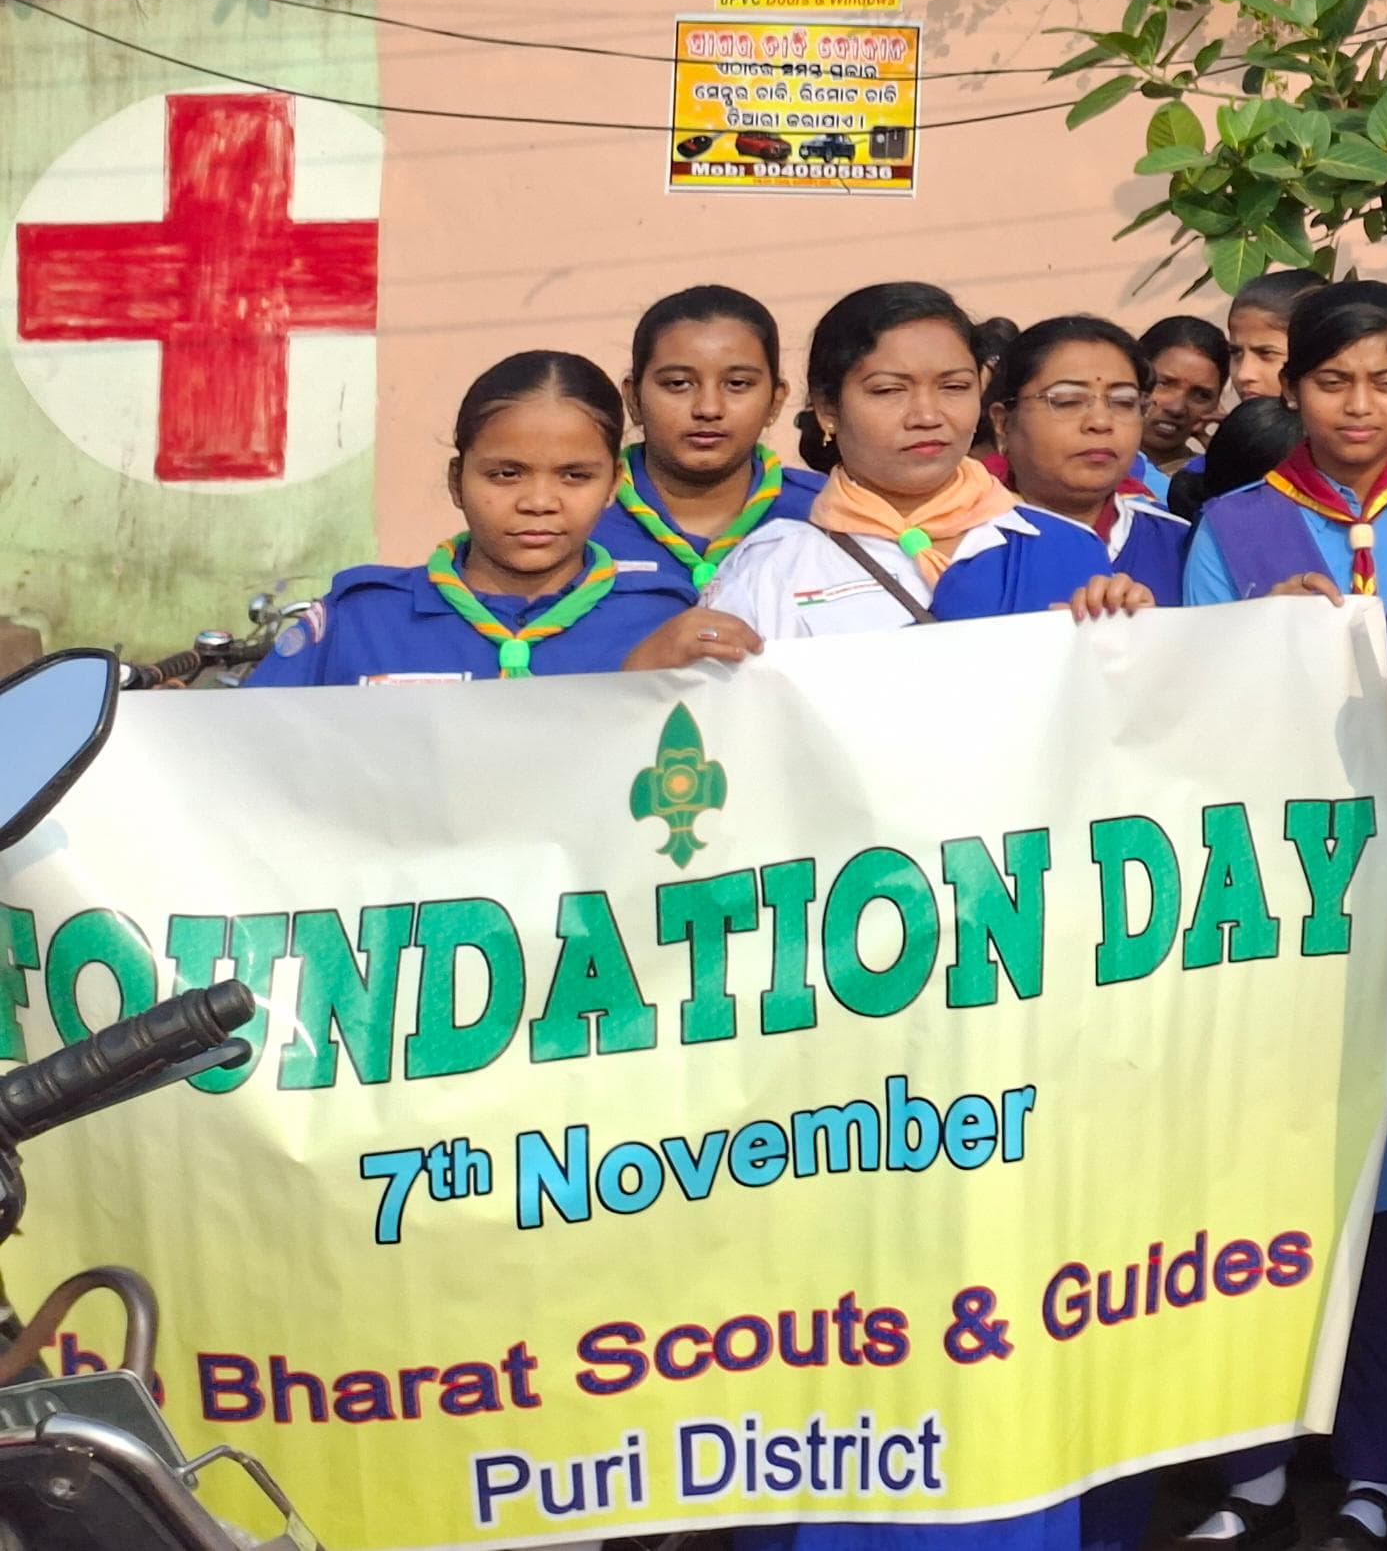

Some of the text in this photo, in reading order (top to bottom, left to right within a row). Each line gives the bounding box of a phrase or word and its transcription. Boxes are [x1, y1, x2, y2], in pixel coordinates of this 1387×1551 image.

[1089, 796, 1378, 989] DAY
[360, 1074, 1037, 1245] 7th November
[196, 1342, 540, 1425] Bharat
[575, 1291, 910, 1398] Scouts
[941, 1286, 1015, 1366] &
[1041, 1230, 1315, 1343] Guides
[473, 1417, 942, 1525] Puri District
